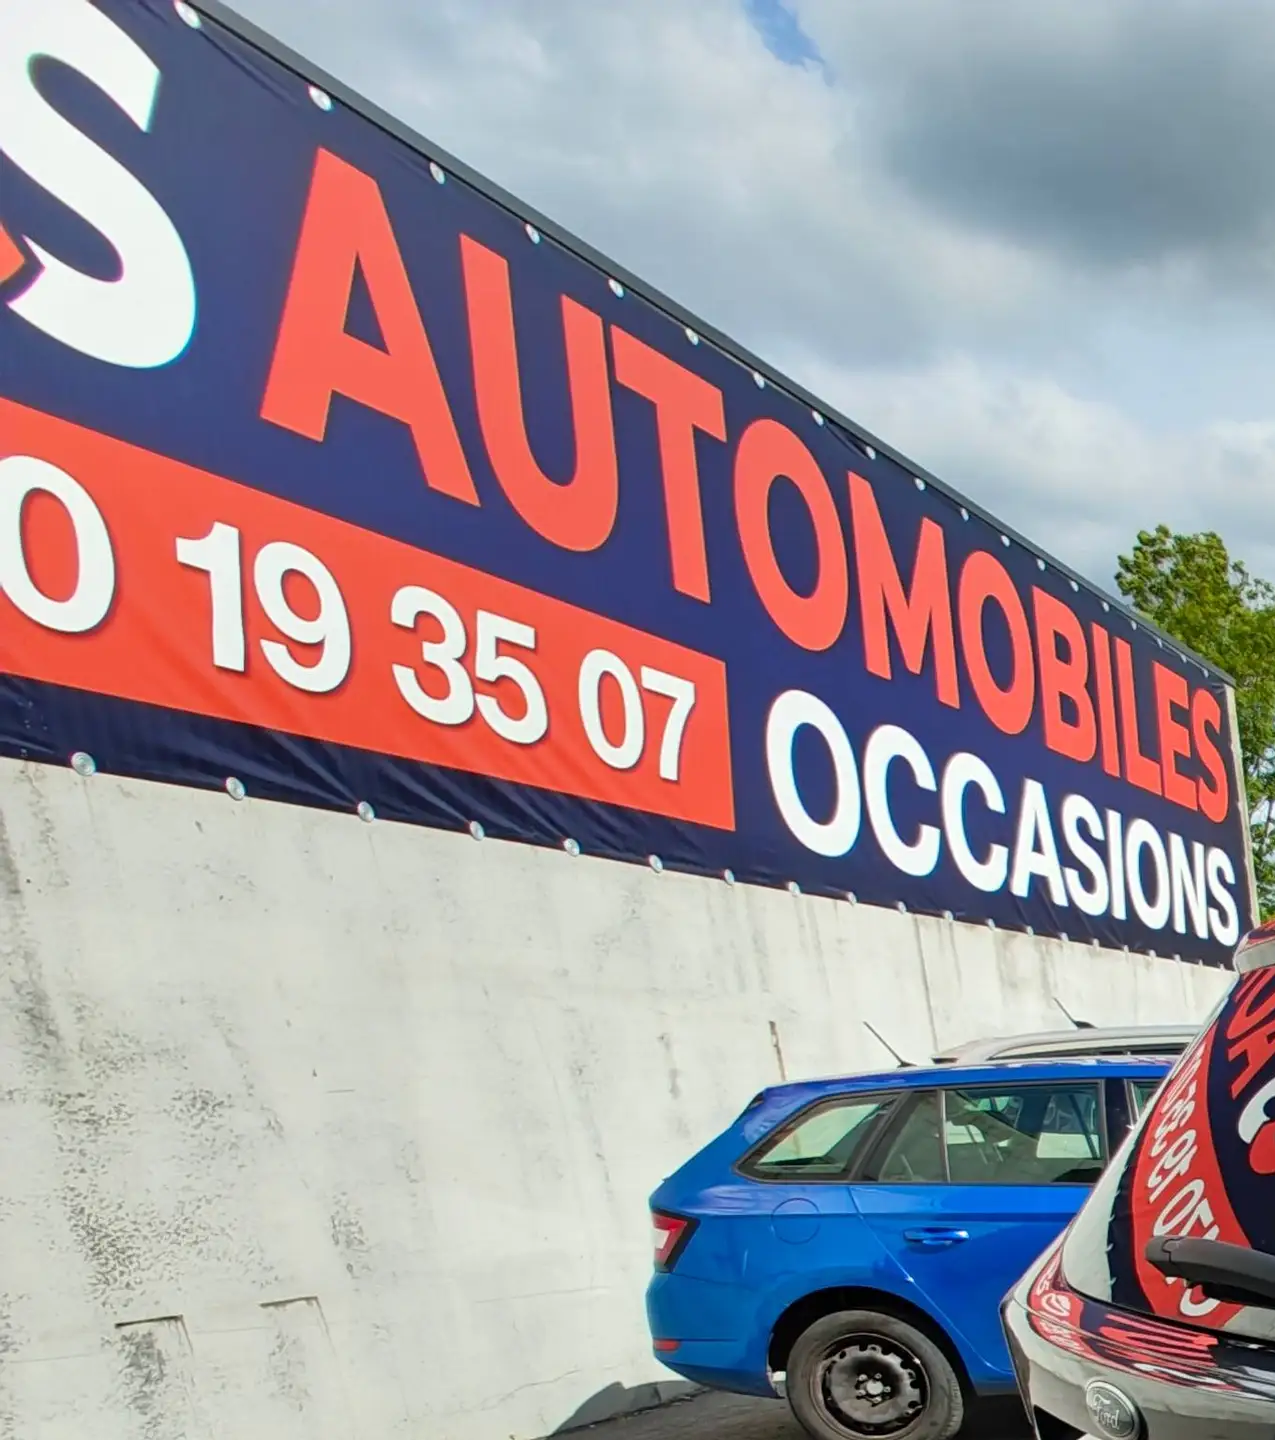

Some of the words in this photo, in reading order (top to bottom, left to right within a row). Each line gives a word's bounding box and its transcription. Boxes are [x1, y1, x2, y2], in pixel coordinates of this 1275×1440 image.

[0, 0, 196, 370] S
[260, 146, 1229, 823] AUTOMOBILES
[175, 521, 352, 694] 19
[390, 585, 549, 745] 35
[578, 649, 697, 783] 07
[765, 689, 1240, 948] OCCASIONS
[1091, 1393, 1121, 1431] Ford
